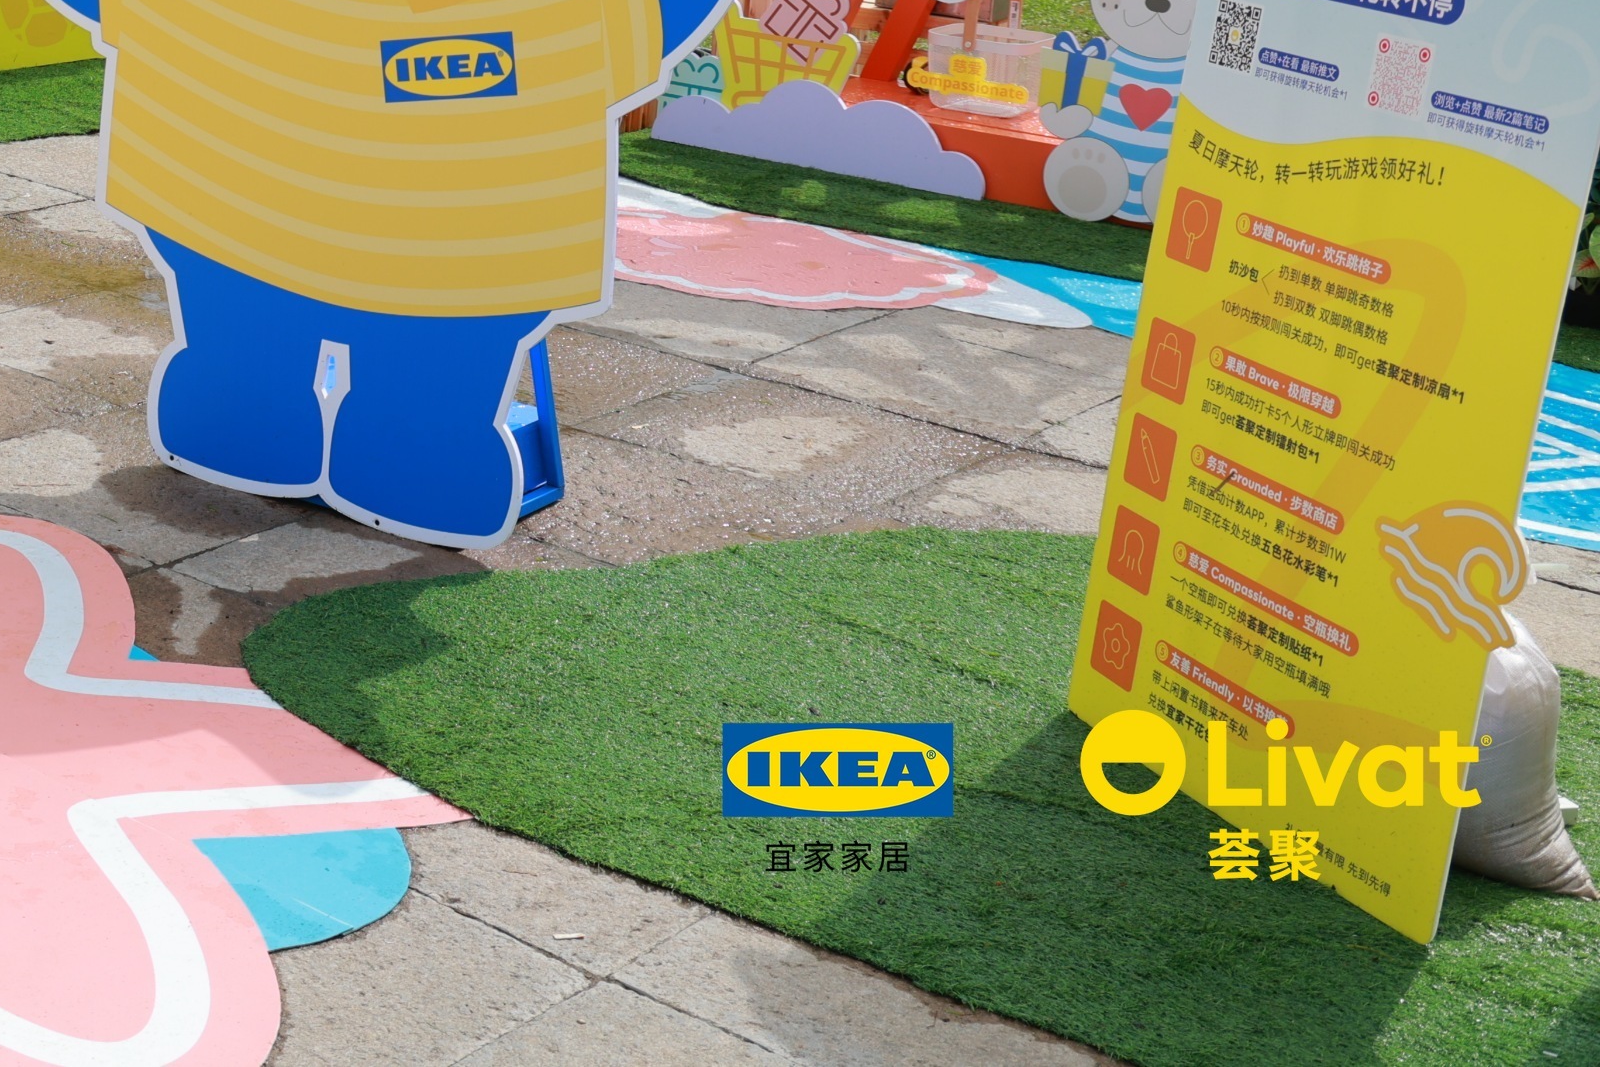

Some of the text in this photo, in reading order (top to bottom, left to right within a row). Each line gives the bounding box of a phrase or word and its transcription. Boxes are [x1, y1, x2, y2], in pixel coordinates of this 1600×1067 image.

[396, 52, 505, 82] IKEA
[911, 72, 1024, 101] Compassionate
[1260, 50, 1337, 80] 点赞+在看 最新推文
[1434, 93, 1546, 133] 浏览+点赞 最新2篇笔记
[1228, 259, 1259, 283] 扔沙包
[1252, 221, 1275, 242] 妙趣
[1276, 231, 1315, 256] Playful
[1322, 246, 1383, 279] 欢乐跳格子
[1273, 290, 1389, 346] 扔到双数 双脚跳偶数格
[1278, 264, 1394, 318] 扔到单数 单脚跳奇数格
[1225, 355, 1246, 376] 果敢
[1248, 366, 1279, 390] Brave
[1287, 381, 1335, 414] 极限穿越
[1206, 377, 1396, 471] 15秒内成功打卡5个人形立牌即闯关成功
[1206, 455, 1227, 477] 务实
[1229, 468, 1282, 503] Grounded
[1290, 496, 1338, 530] 步数商店
[1188, 552, 1210, 576] 慈爱
[1211, 567, 1294, 621] Compassionate
[1303, 615, 1352, 652] 空瓶换礼
[1165, 593, 1331, 699] 鲨鱼形架子在等待大家用空瓶填满哦
[1170, 652, 1191, 675] 友善
[1192, 666, 1234, 703] Friendly
[1347, 862, 1391, 897] 先到先得
